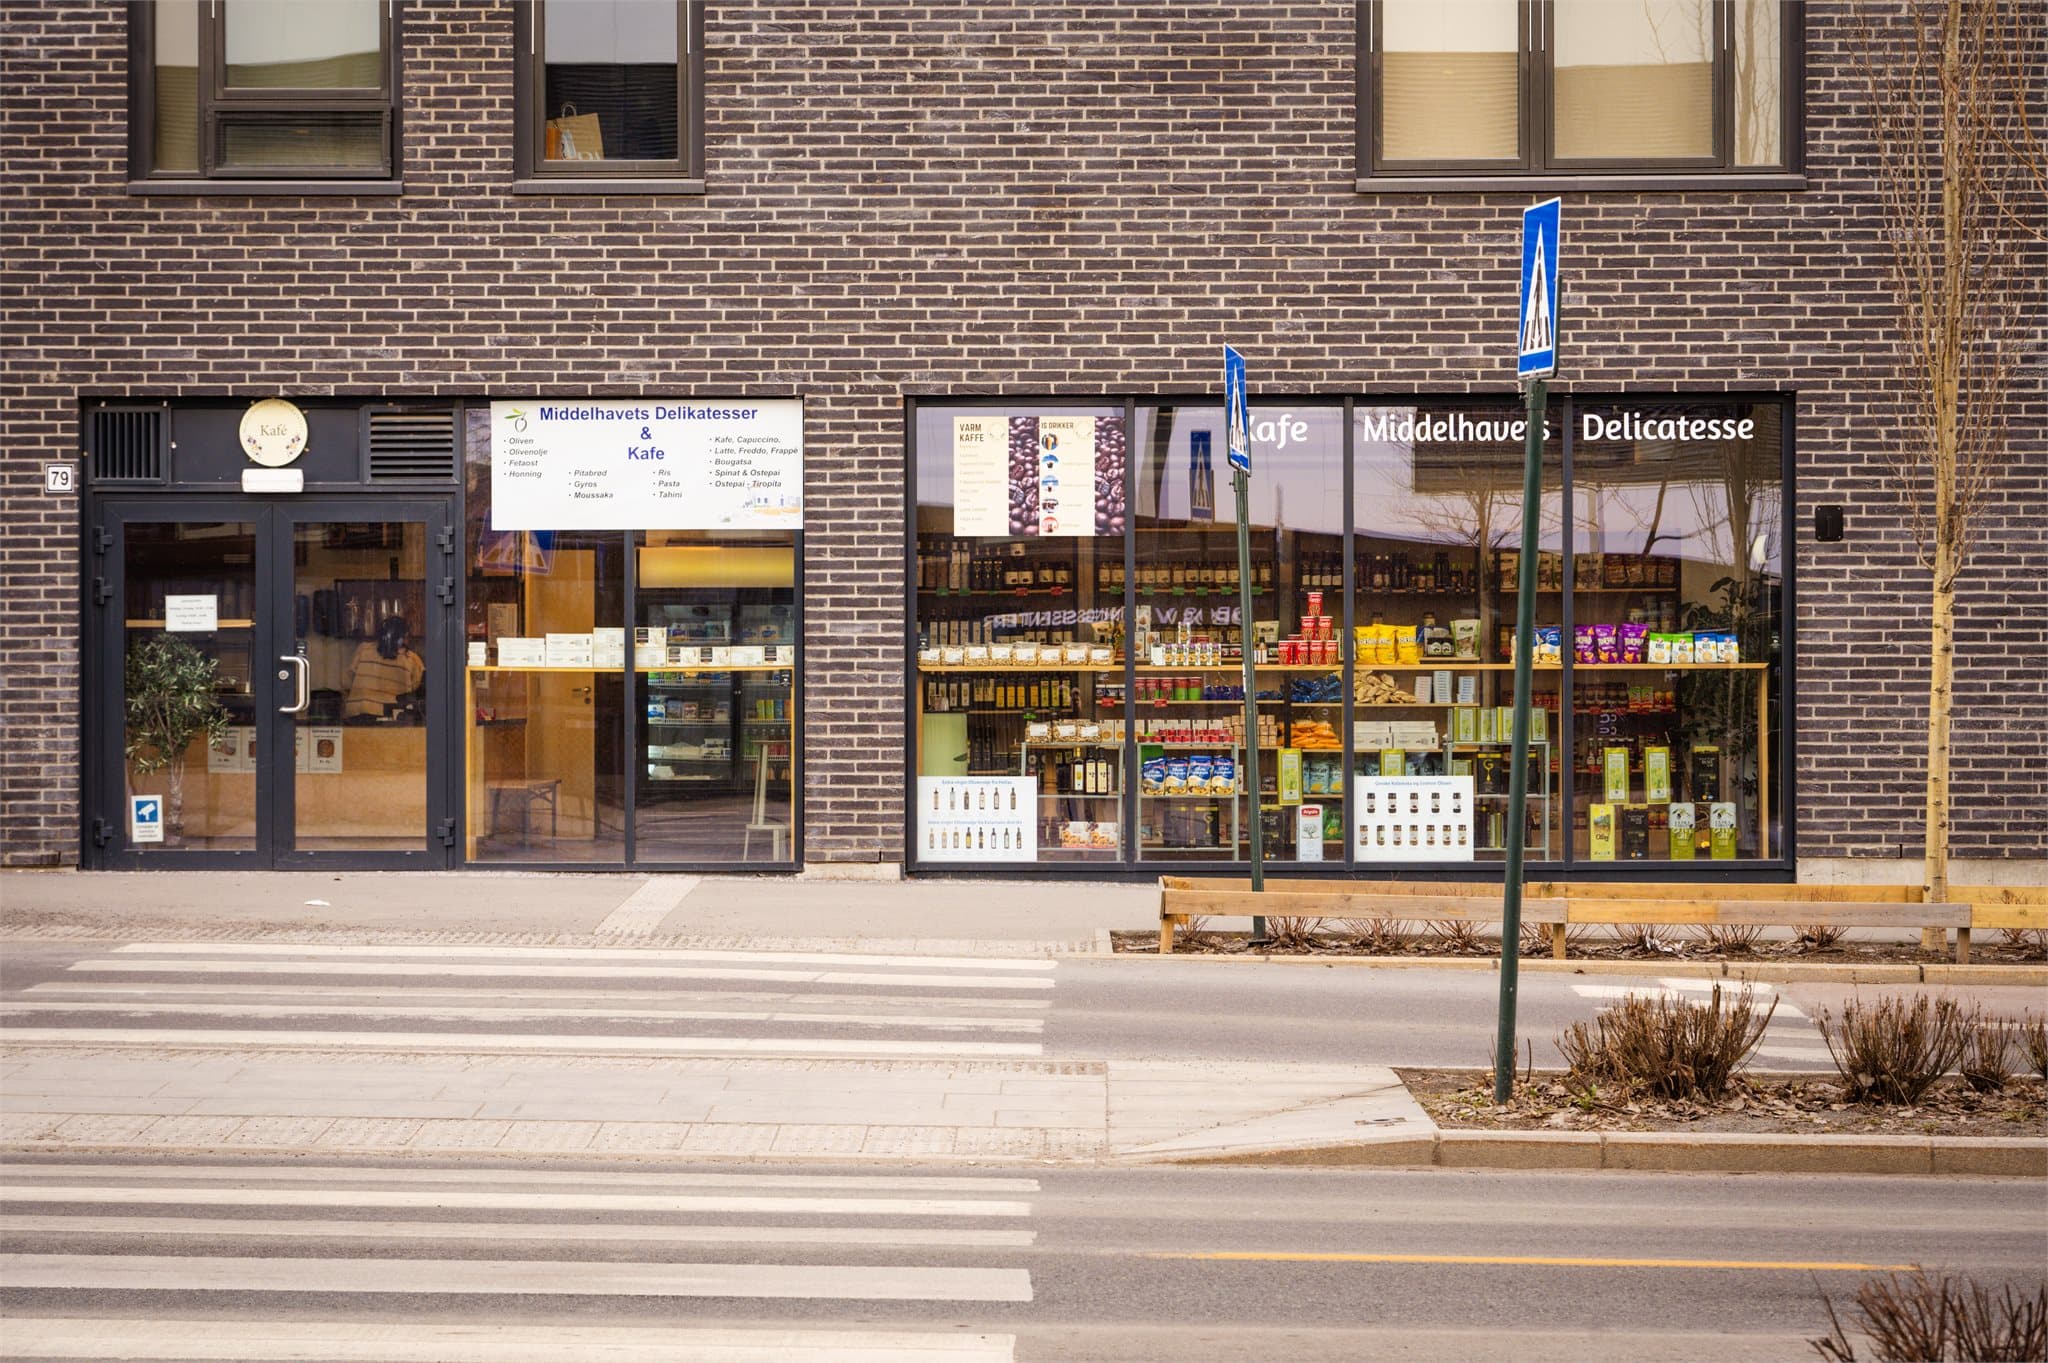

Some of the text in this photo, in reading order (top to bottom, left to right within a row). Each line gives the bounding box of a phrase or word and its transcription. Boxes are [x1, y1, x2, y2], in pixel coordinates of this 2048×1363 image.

[540, 406, 758, 421] Middelhavets Delikatesser
[260, 424, 287, 436] Kafé
[960, 423, 981, 432] VARM
[1363, 413, 1551, 441] Middelhaves
[1583, 412, 1754, 441] Delicatesse
[640, 426, 652, 440] &
[509, 437, 534, 445] Oliven
[960, 434, 984, 442] KAFFE
[509, 448, 548, 457] Olivenolje
[628, 447, 665, 460] Kafe
[714, 458, 752, 466] Bougatsa
[509, 470, 542, 478] Honning
[658, 469, 671, 477] Ris
[714, 469, 740, 478] Spinat
[750, 469, 780, 478] Ostepai
[51, 471, 69, 486] 79
[574, 481, 598, 489] Gyros
[658, 480, 681, 488] Pasta
[715, 480, 745, 489] Ostepai
[752, 480, 782, 489] Tiropita
[659, 491, 683, 499] Tahini
